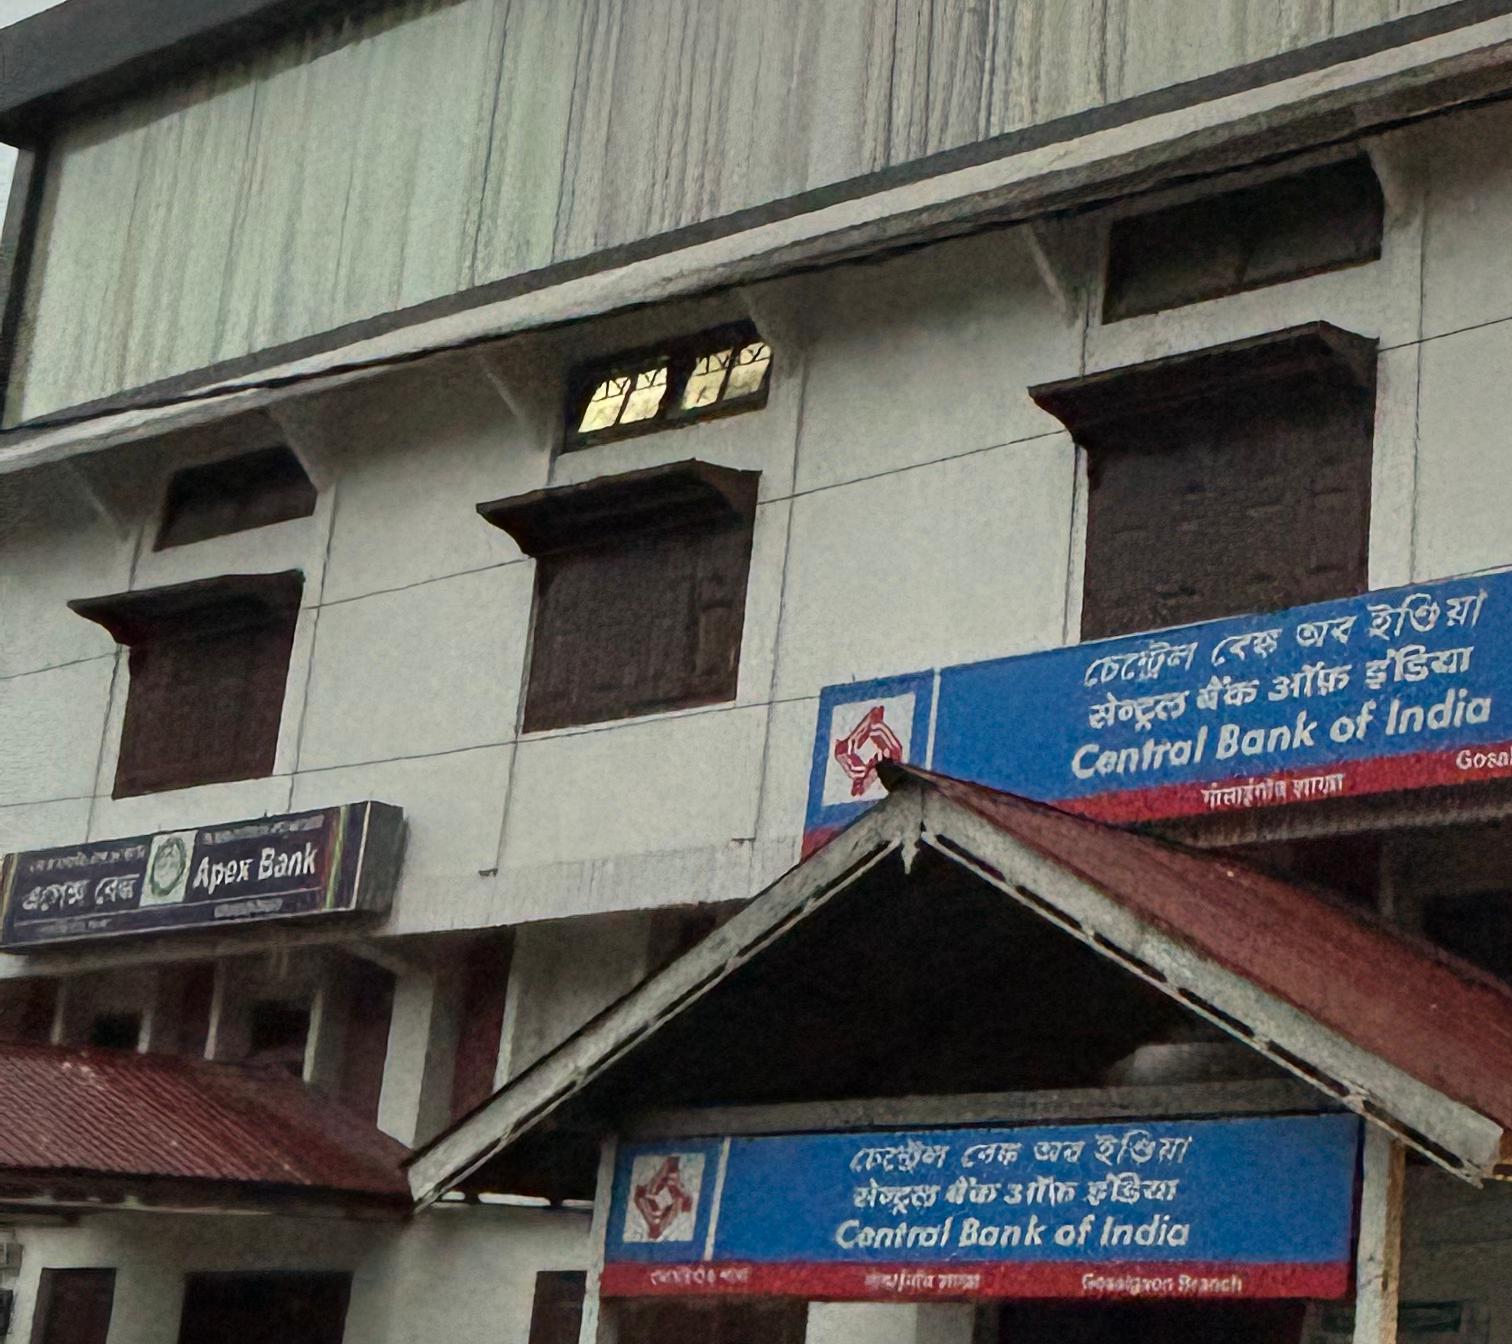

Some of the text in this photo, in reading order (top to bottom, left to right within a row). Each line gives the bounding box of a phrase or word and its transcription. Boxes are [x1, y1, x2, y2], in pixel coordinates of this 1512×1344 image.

[1071, 688, 1491, 780] Central Bank of India
[192, 856, 254, 895] Apex
[257, 841, 318, 881] Bank
[835, 1213, 1191, 1250] Central Bank of India
[1178, 1273, 1243, 1293] Branch
